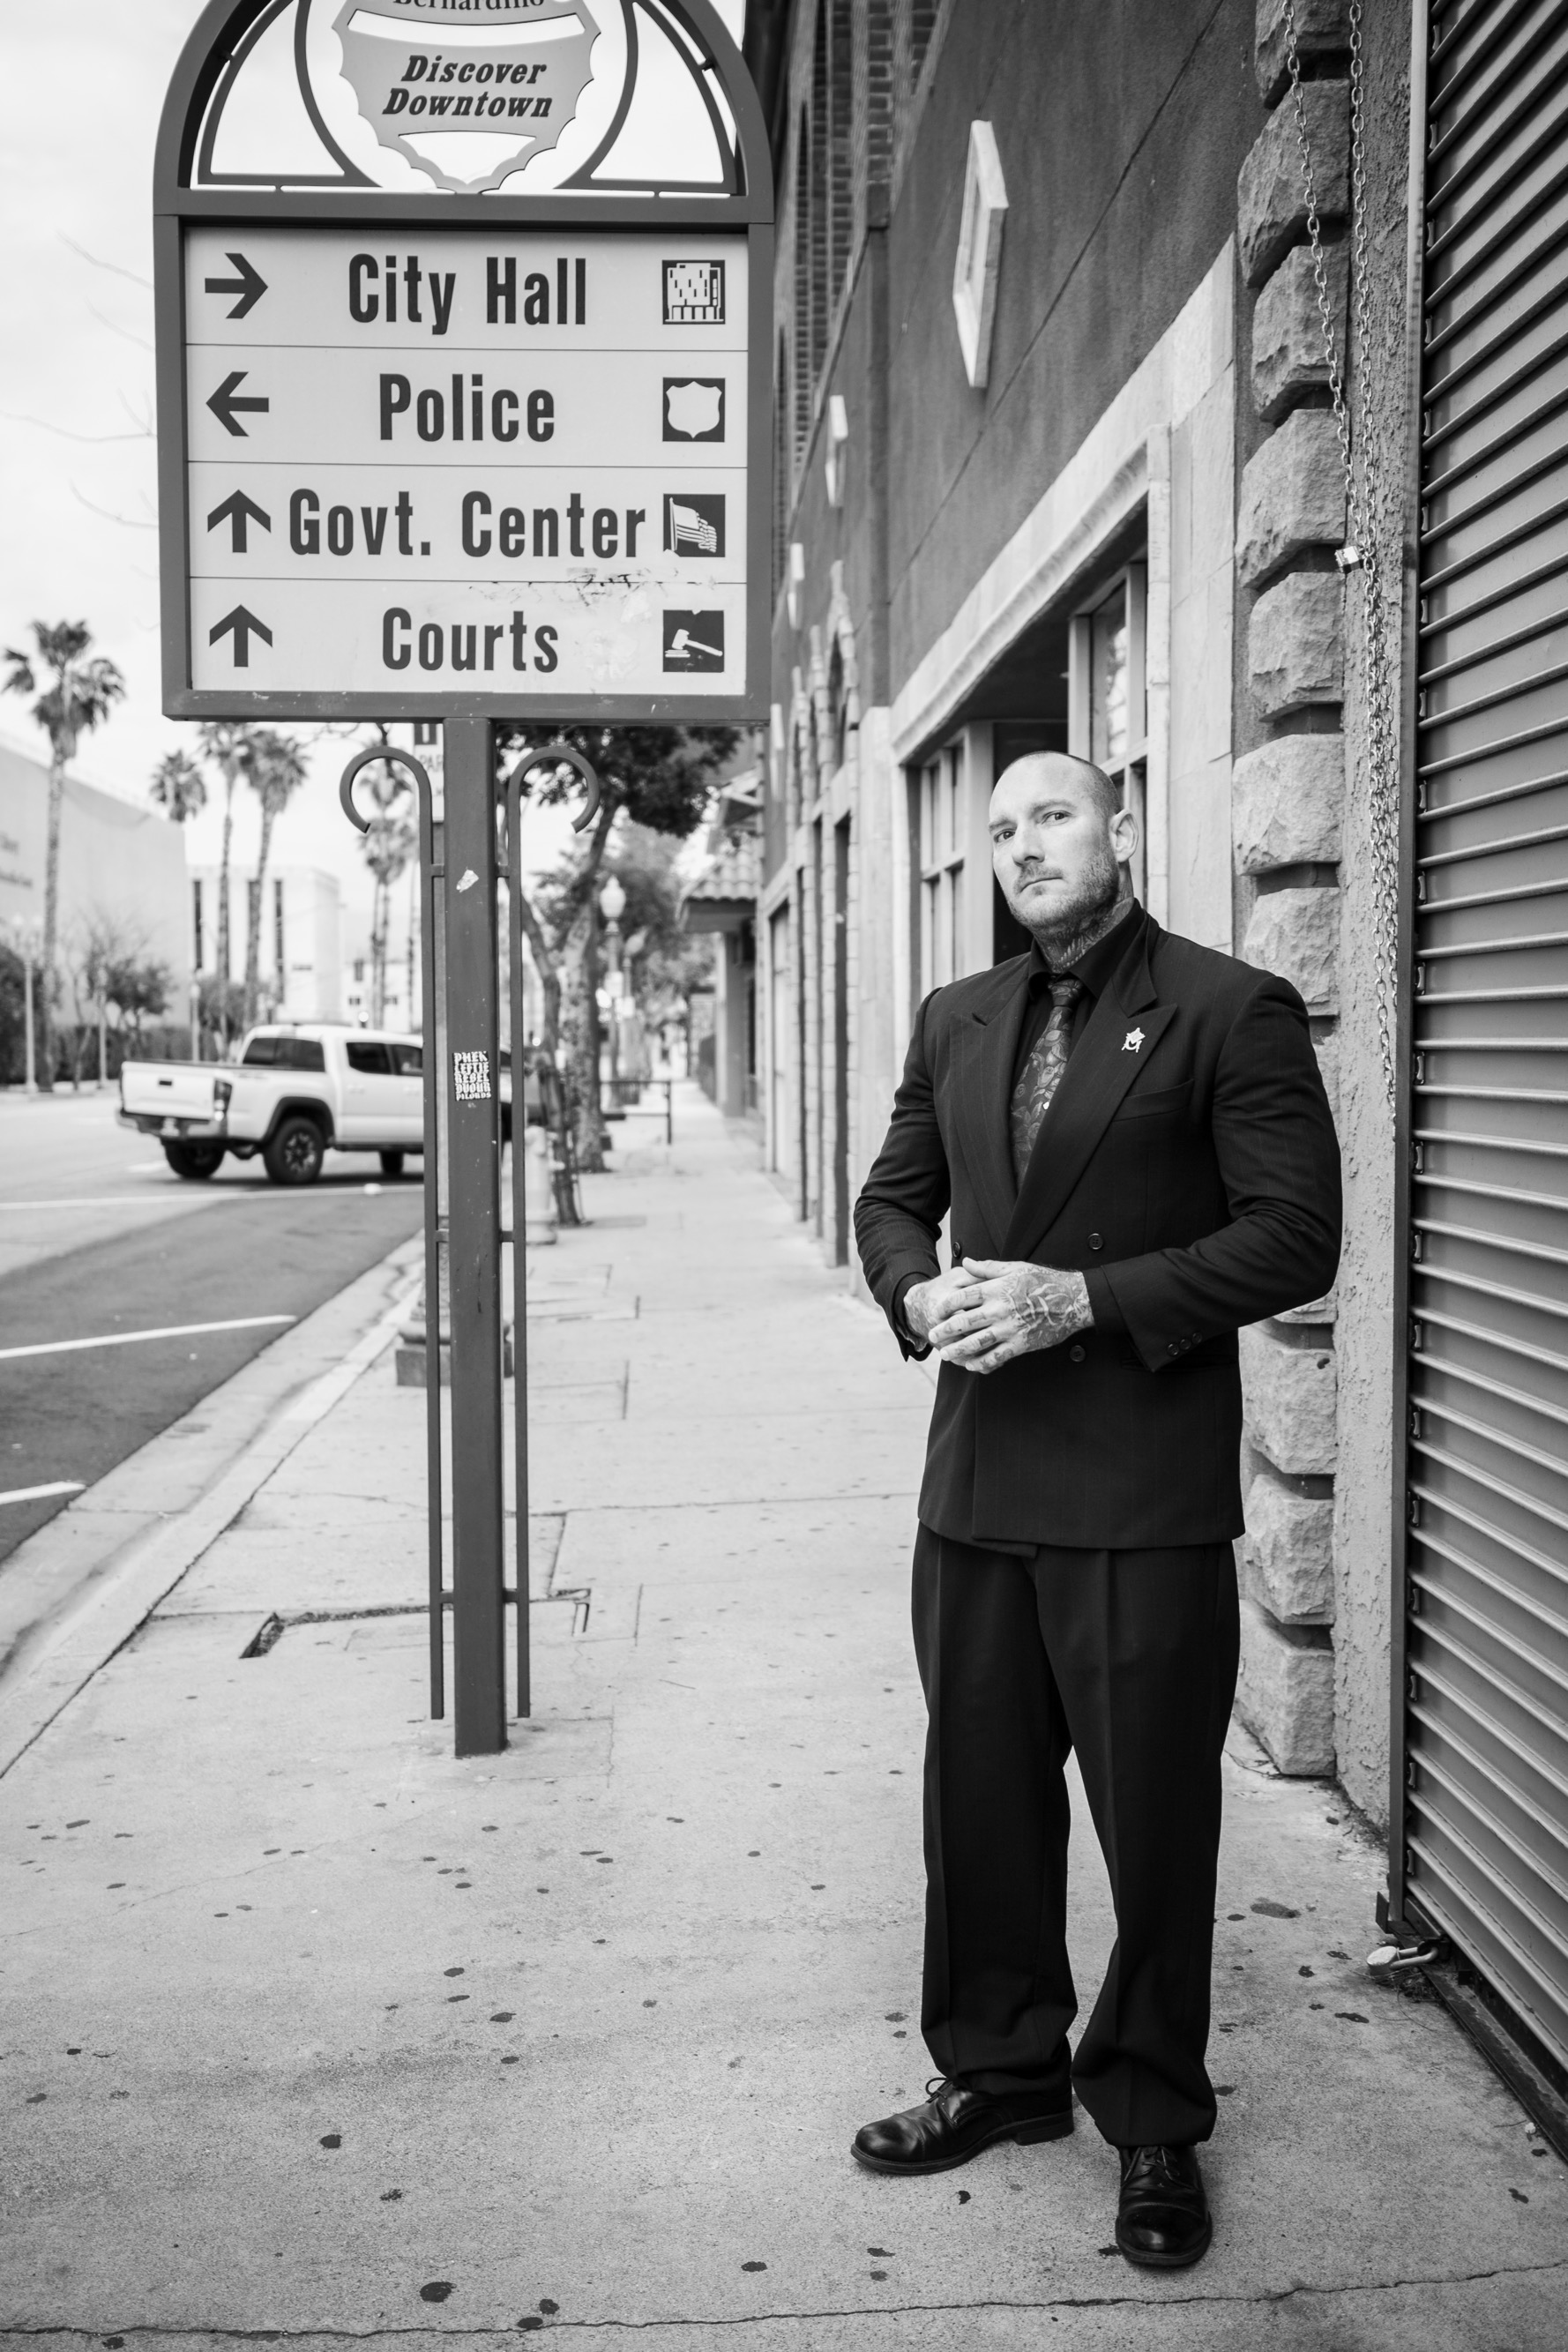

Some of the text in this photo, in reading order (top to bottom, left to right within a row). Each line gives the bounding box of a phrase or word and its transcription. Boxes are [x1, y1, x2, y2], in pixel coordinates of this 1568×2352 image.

[382, 87, 553, 117] Downtown
[400, 55, 547, 84] Discover
[348, 253, 586, 335] City Hall
[379, 373, 555, 443] Police
[289, 489, 646, 559] Govt. Center
[383, 607, 558, 673] Courts
